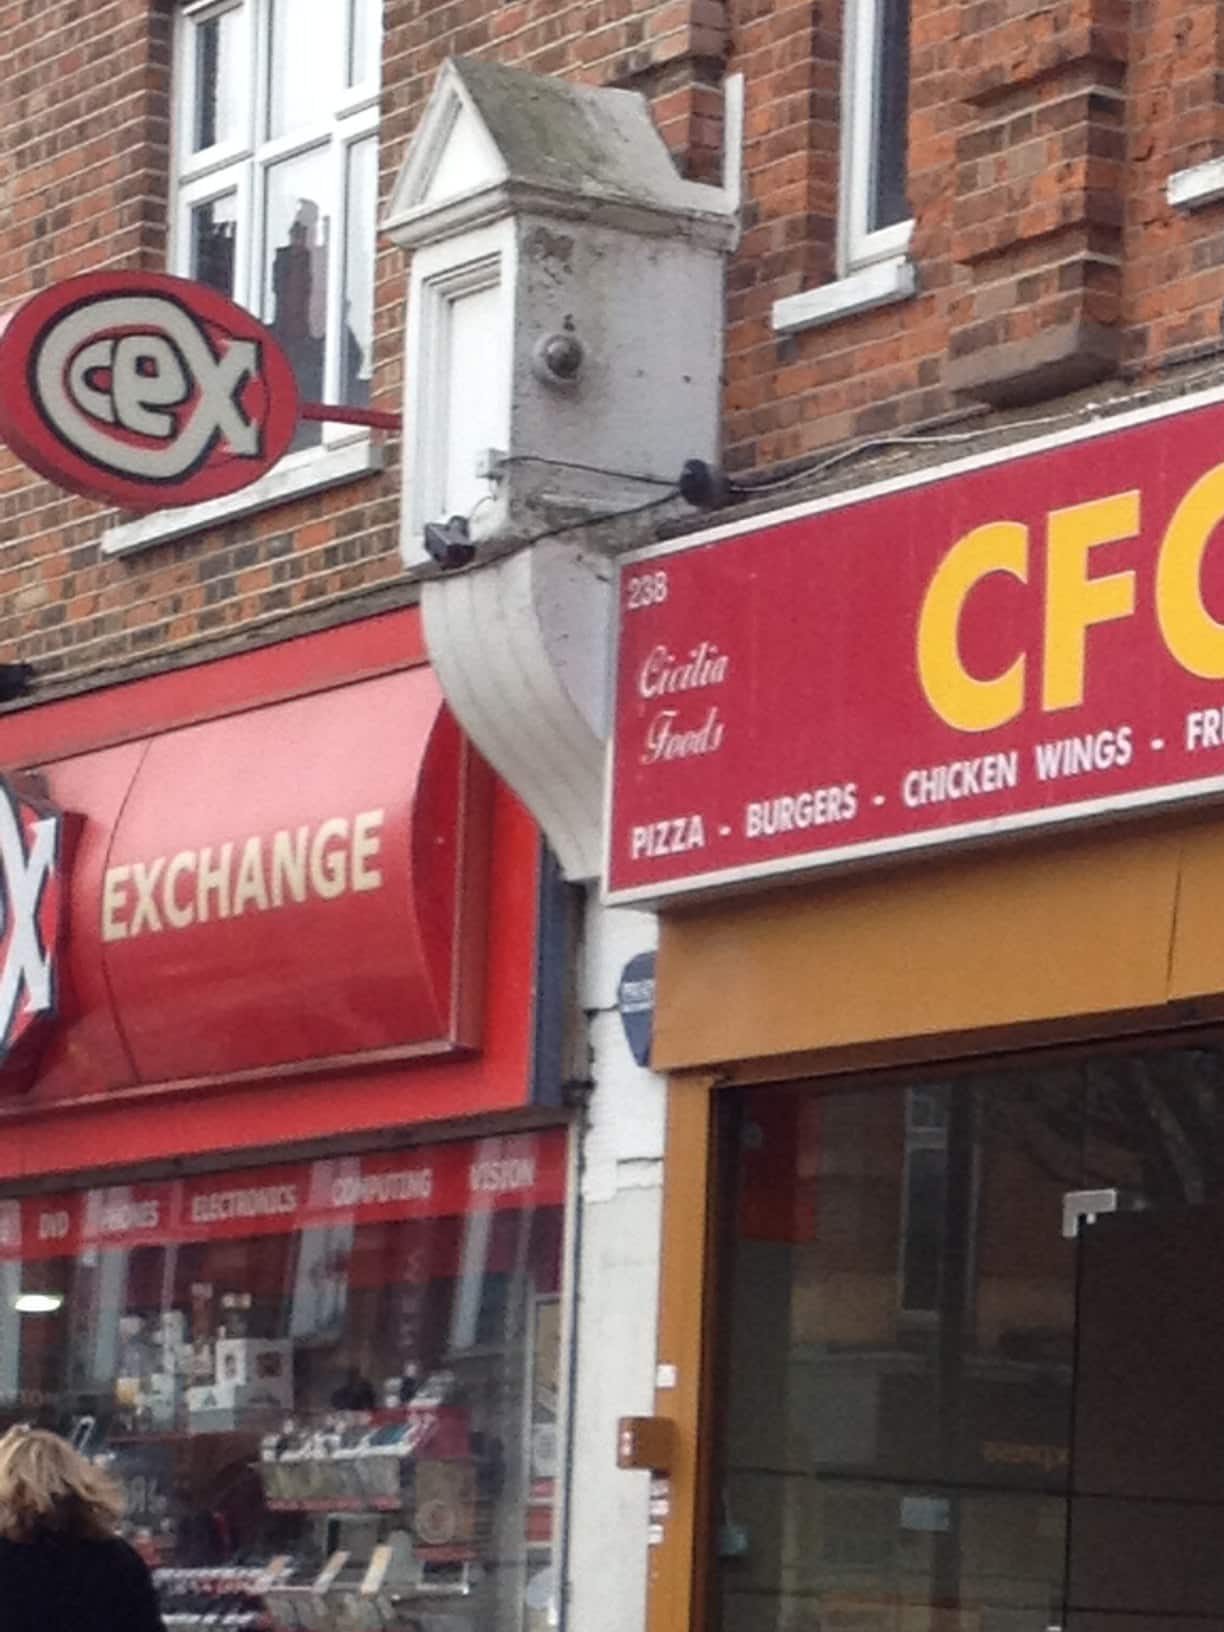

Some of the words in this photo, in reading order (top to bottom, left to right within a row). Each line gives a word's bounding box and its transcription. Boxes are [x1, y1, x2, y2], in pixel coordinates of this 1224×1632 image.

[626, 571, 668, 609] 238
[631, 815, 704, 860] PIZZA
[746, 783, 857, 838] BURGERS
[903, 752, 1019, 808] CHICKEN
[1035, 726, 1132, 780] WINGS
[103, 809, 384, 942] EXCHANGE
